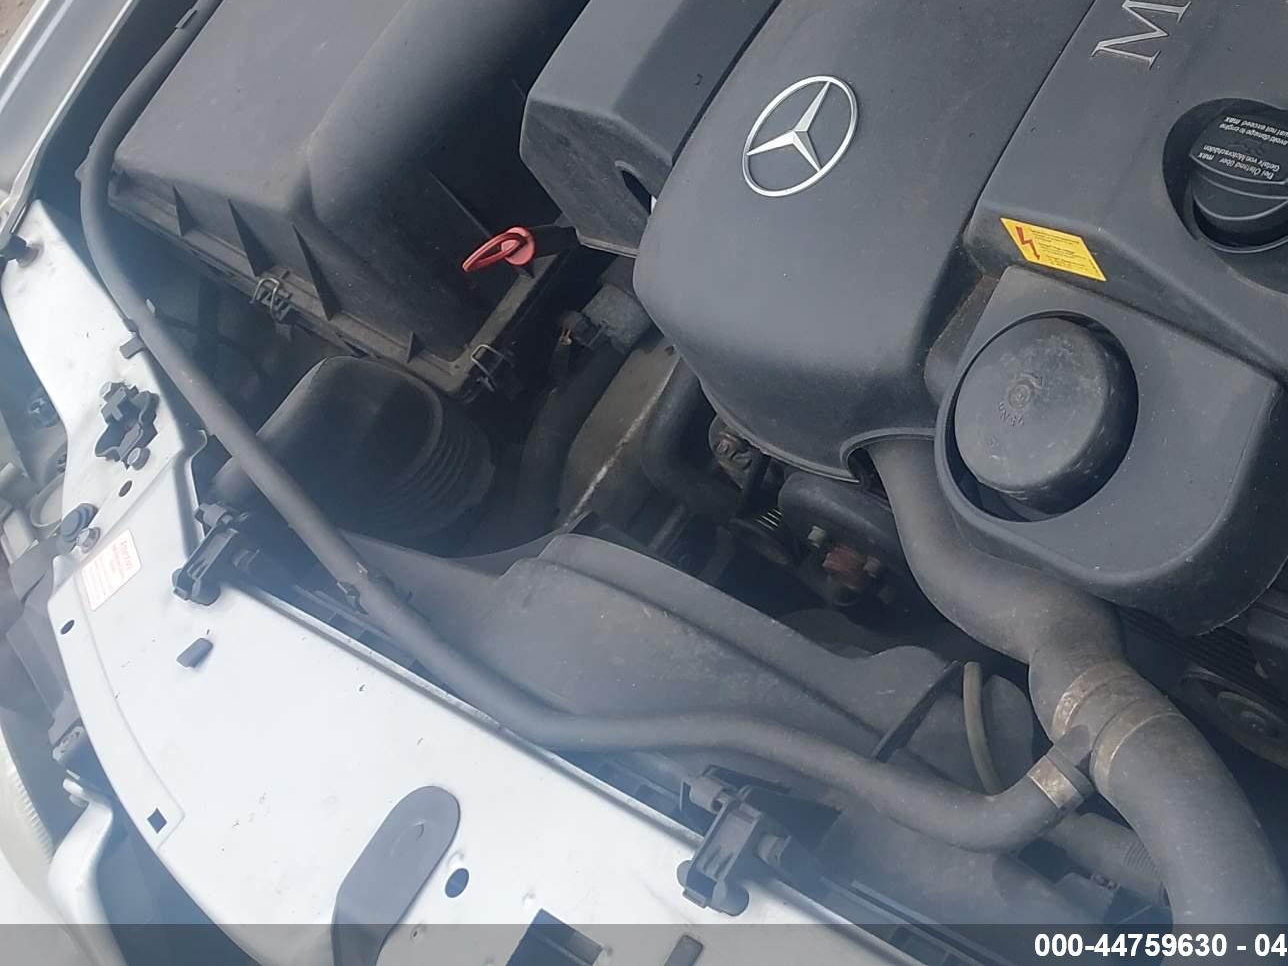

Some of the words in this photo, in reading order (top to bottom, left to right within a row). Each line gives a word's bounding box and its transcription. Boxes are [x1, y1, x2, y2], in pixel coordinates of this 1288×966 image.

[1224, 116, 1241, 124] max
[1241, 120, 1266, 131] exceed
[1265, 126, 1276, 134] not
[1245, 130, 1271, 140] damage
[1270, 136, 1288, 146] avoid
[1198, 152, 1215, 160] max
[1246, 155, 1258, 164] von
